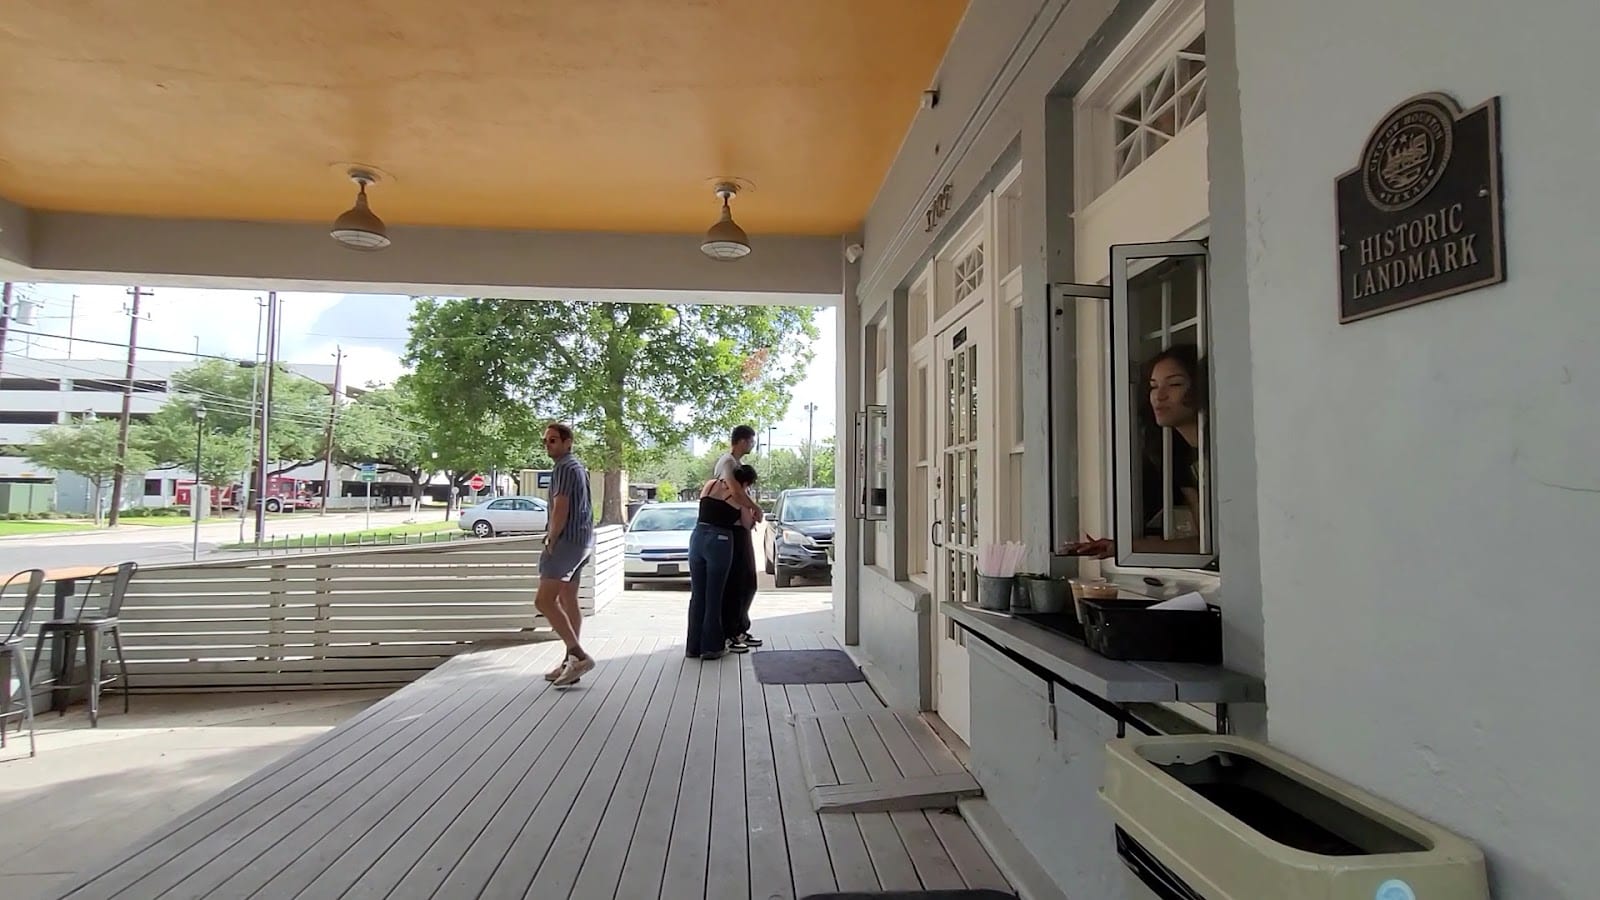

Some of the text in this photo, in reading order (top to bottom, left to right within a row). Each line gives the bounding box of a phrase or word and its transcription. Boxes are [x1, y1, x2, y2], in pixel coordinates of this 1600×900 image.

[1370, 112, 1444, 172] CITY OF HOUSTON
[1386, 178, 1428, 203] TEXAS
[1360, 203, 1464, 266] HISTORIC
[1353, 233, 1479, 300] LANDMARK
